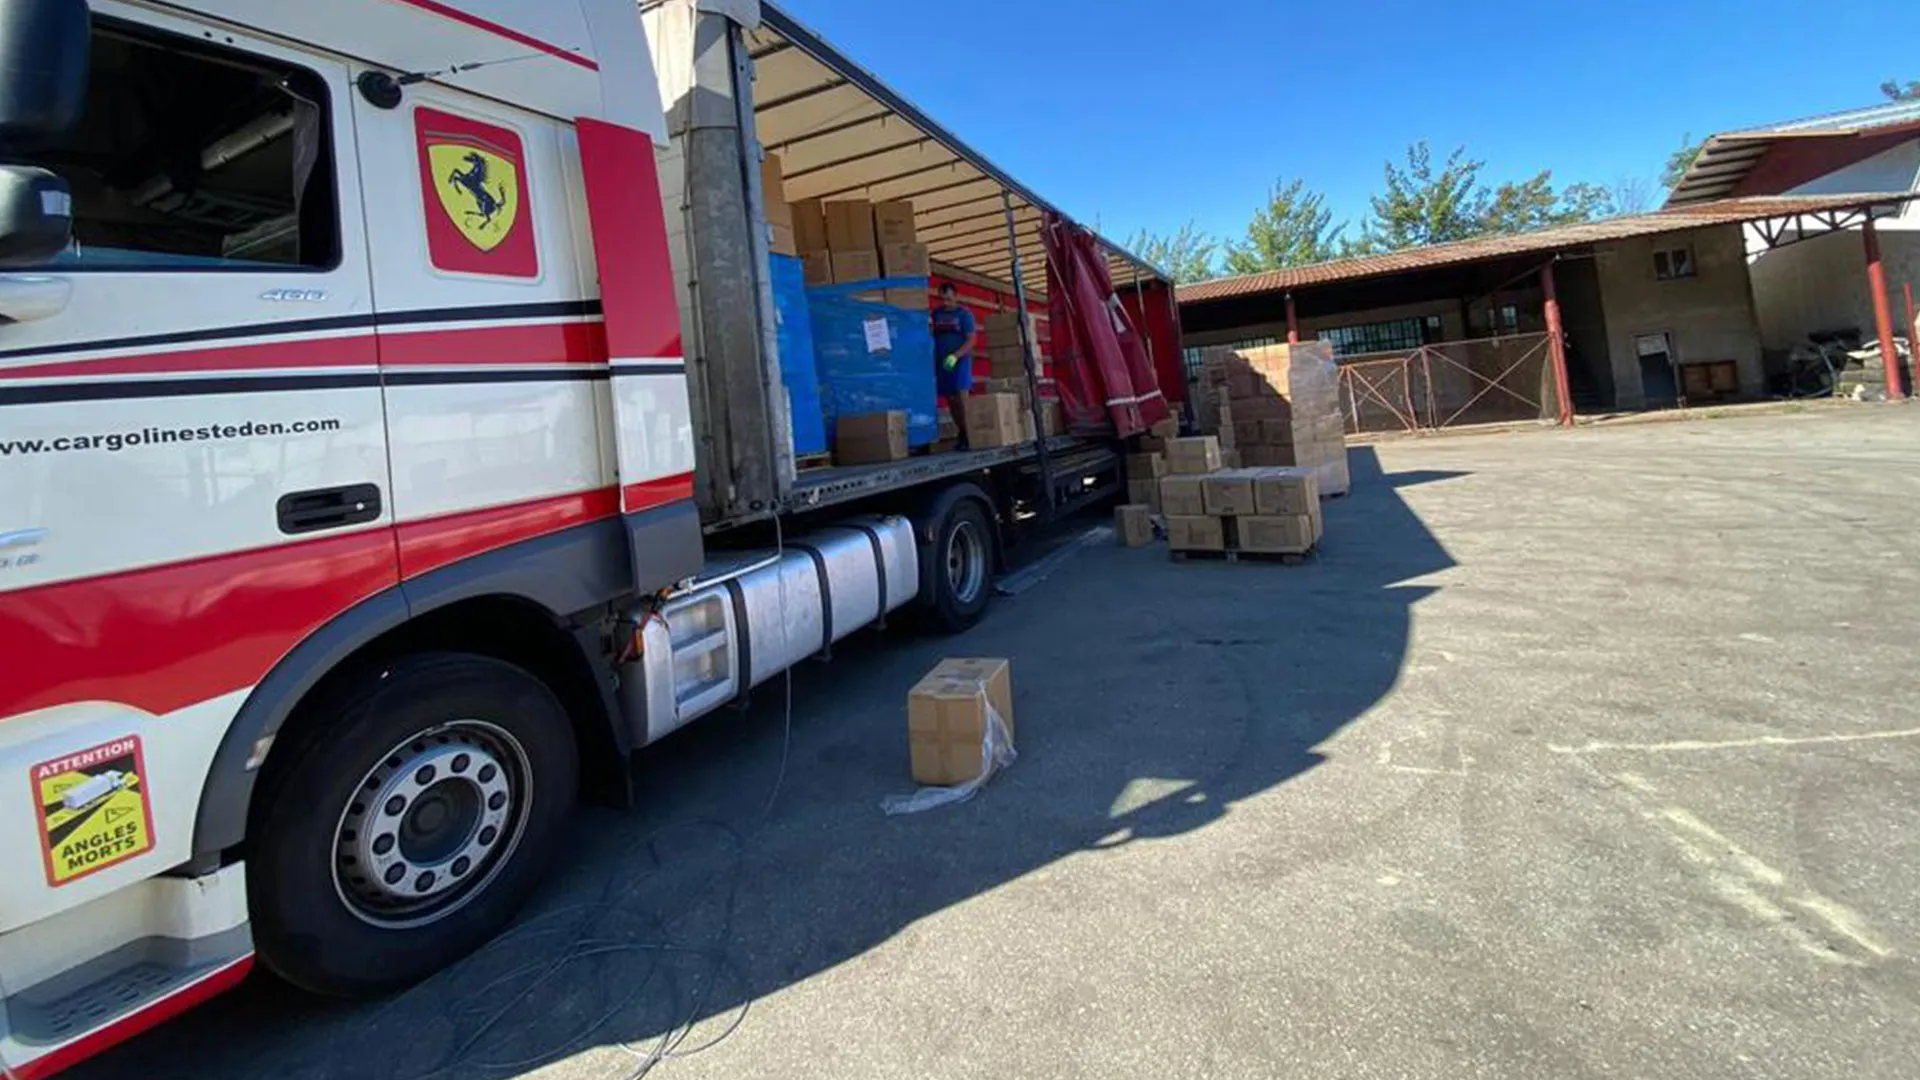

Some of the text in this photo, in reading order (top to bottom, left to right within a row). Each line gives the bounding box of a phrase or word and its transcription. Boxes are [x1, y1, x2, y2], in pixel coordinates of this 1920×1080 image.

[38, 739, 135, 779] ATTENTION
[62, 821, 138, 859] ANGLES
[68, 836, 136, 870] MORTS
